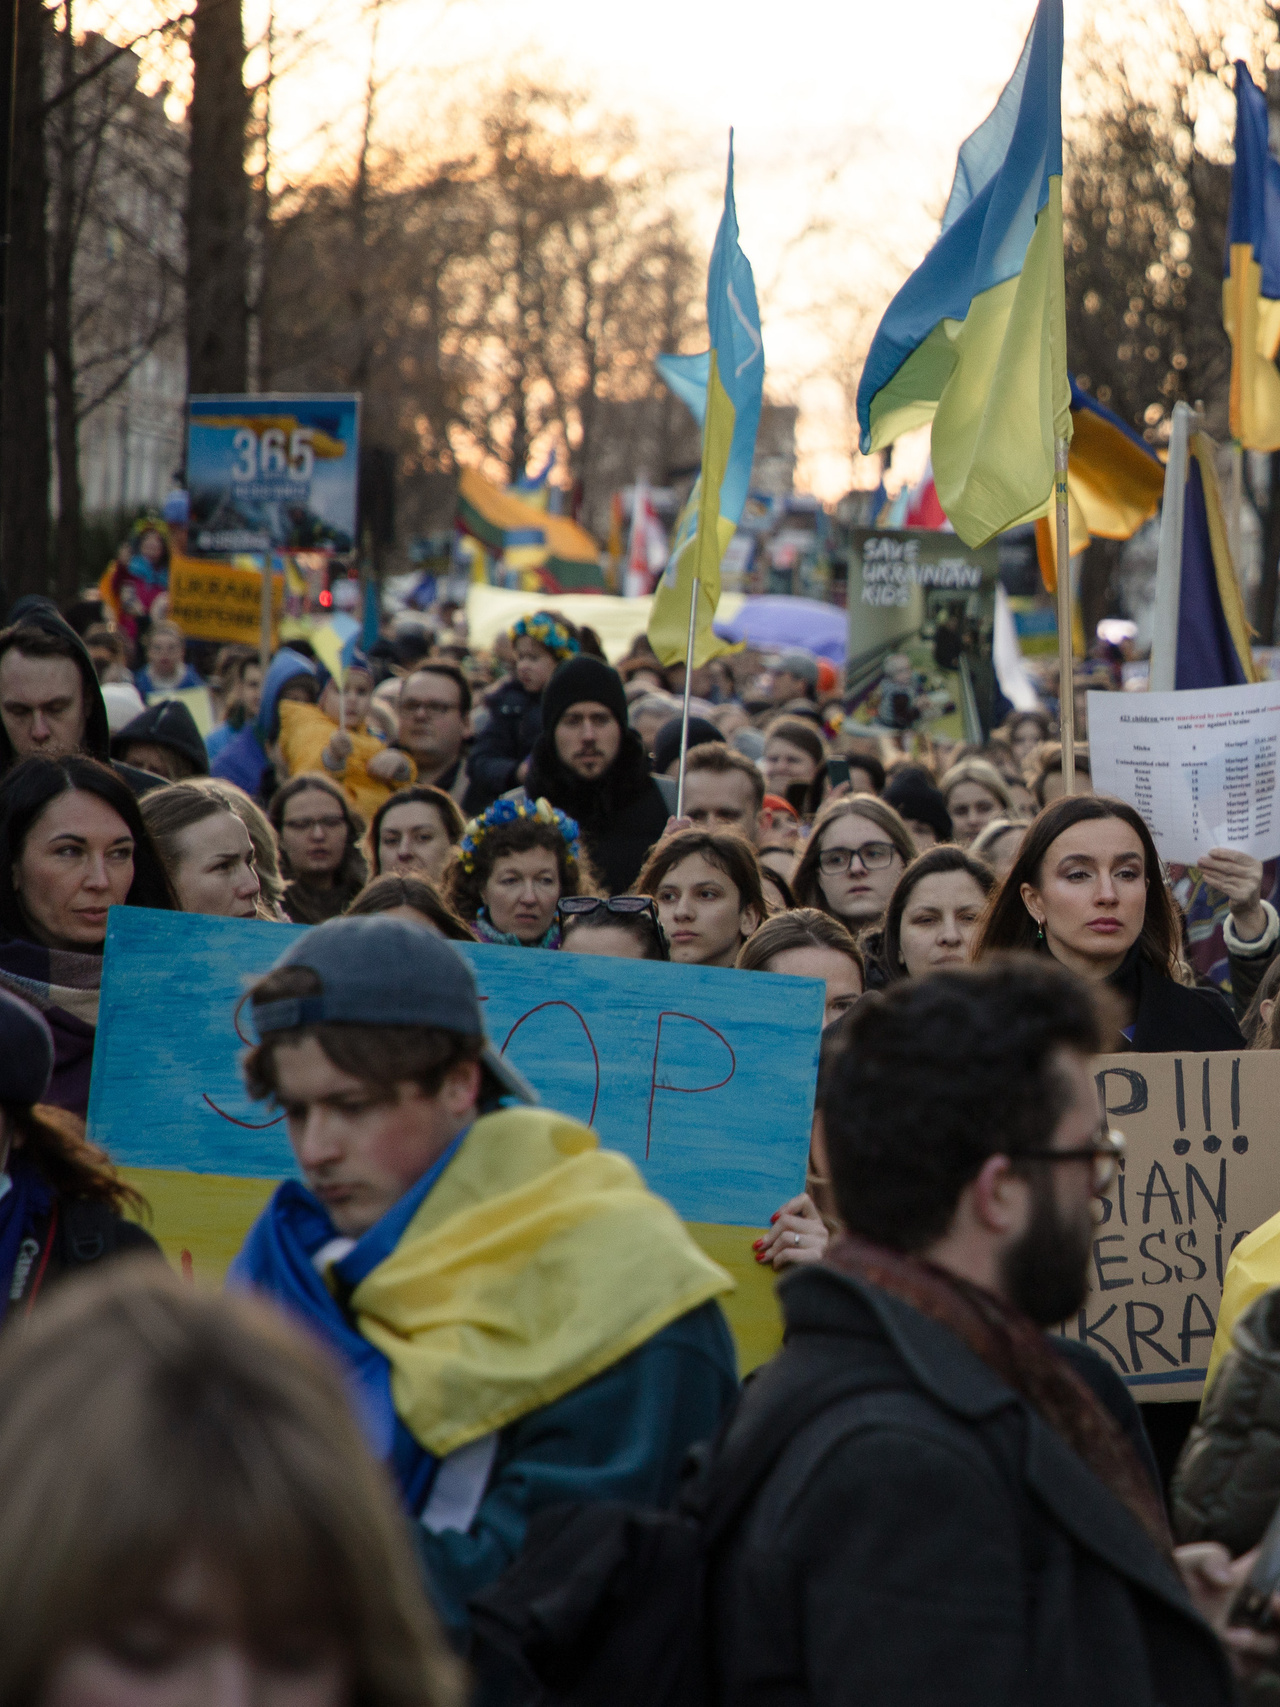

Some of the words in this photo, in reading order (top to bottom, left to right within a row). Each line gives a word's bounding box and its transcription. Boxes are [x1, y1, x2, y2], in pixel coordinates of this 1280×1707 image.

[233, 428, 314, 481] 365
[863, 537, 919, 560] SAVE
[863, 559, 982, 588] UKRAINIAN
[862, 584, 909, 608] KIDS
[1132, 715, 1158, 723] children
